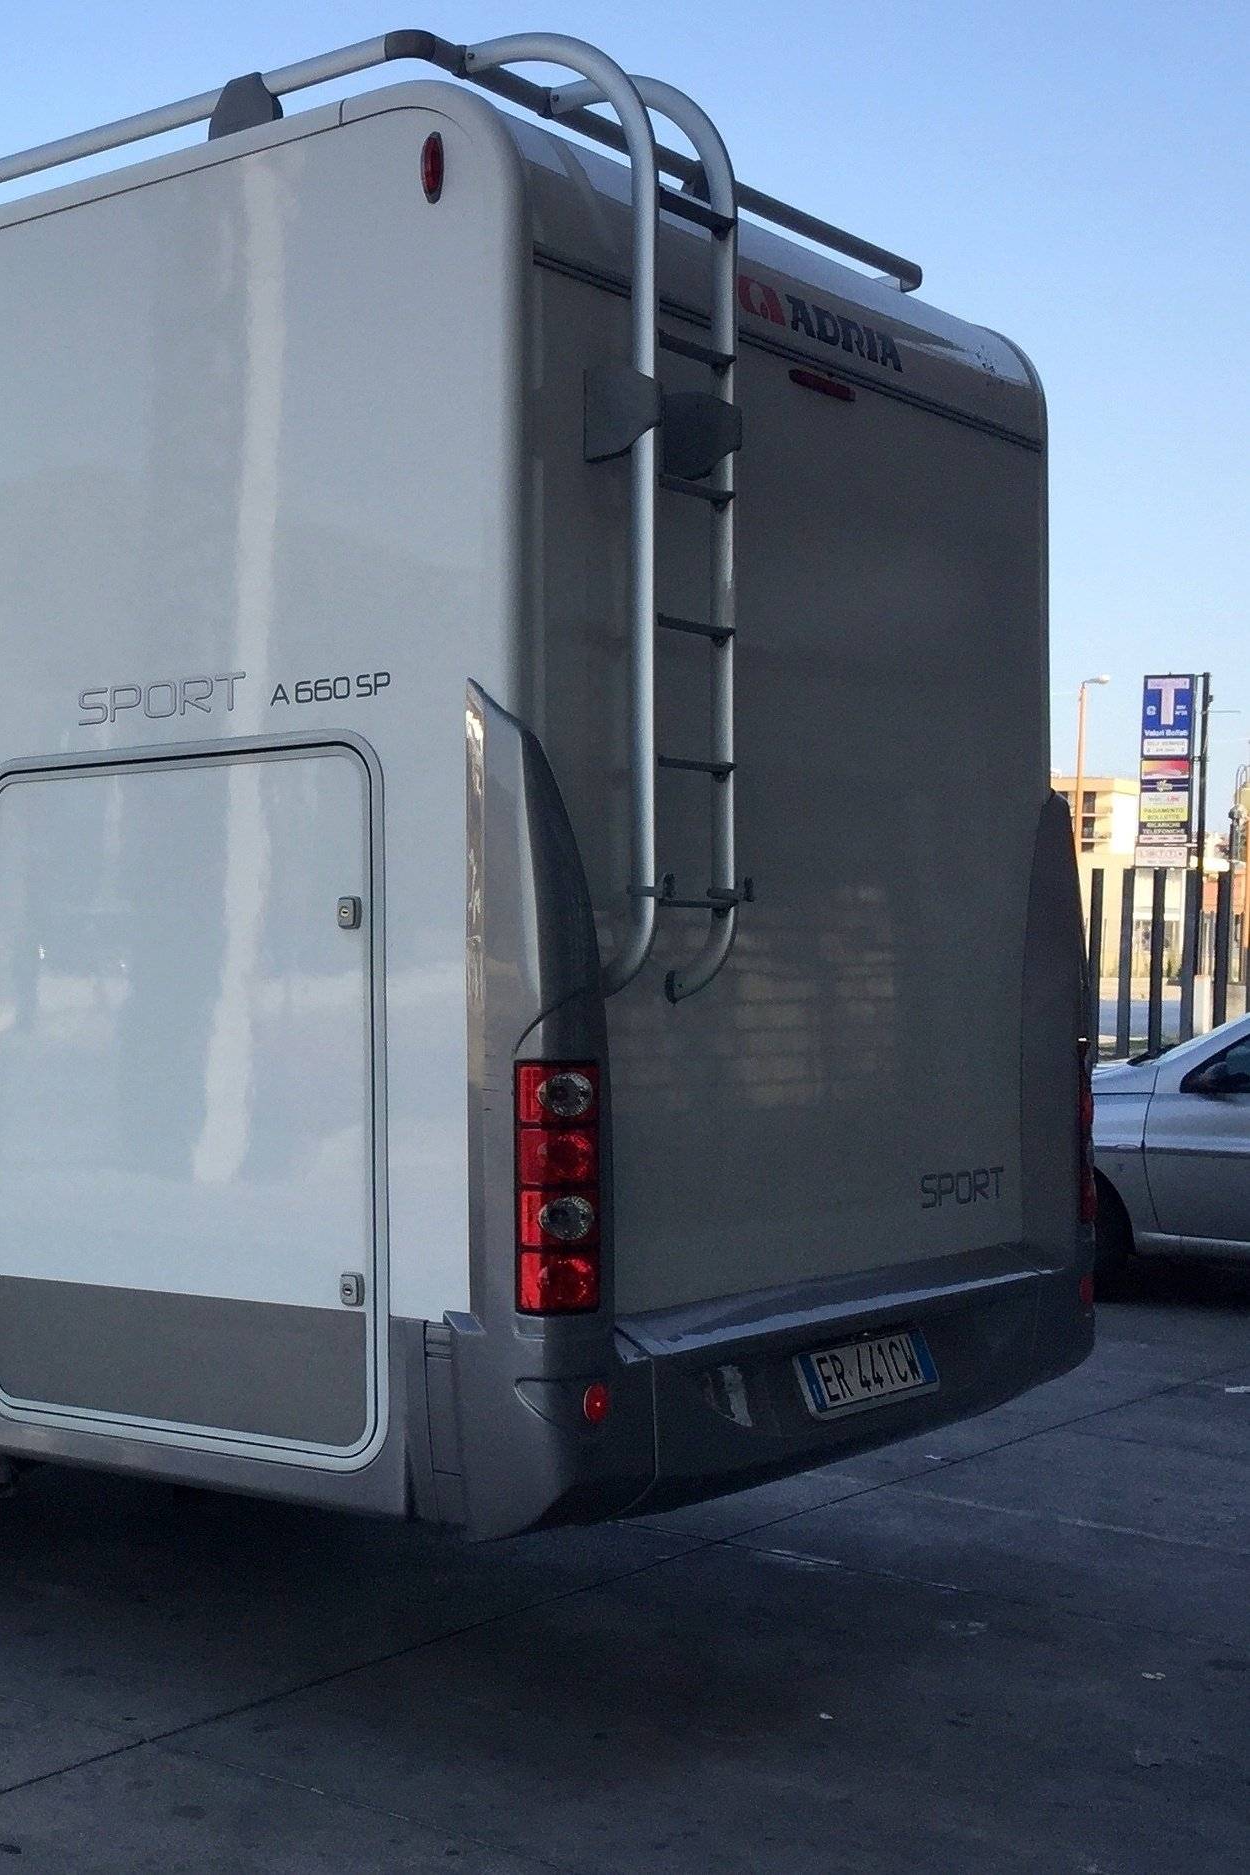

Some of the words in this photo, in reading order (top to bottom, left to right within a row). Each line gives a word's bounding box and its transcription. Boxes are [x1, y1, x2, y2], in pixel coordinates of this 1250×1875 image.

[785, 293, 903, 373] ADRIA
[78, 670, 247, 726] SPORT
[920, 1166, 1004, 1209] SPORT
